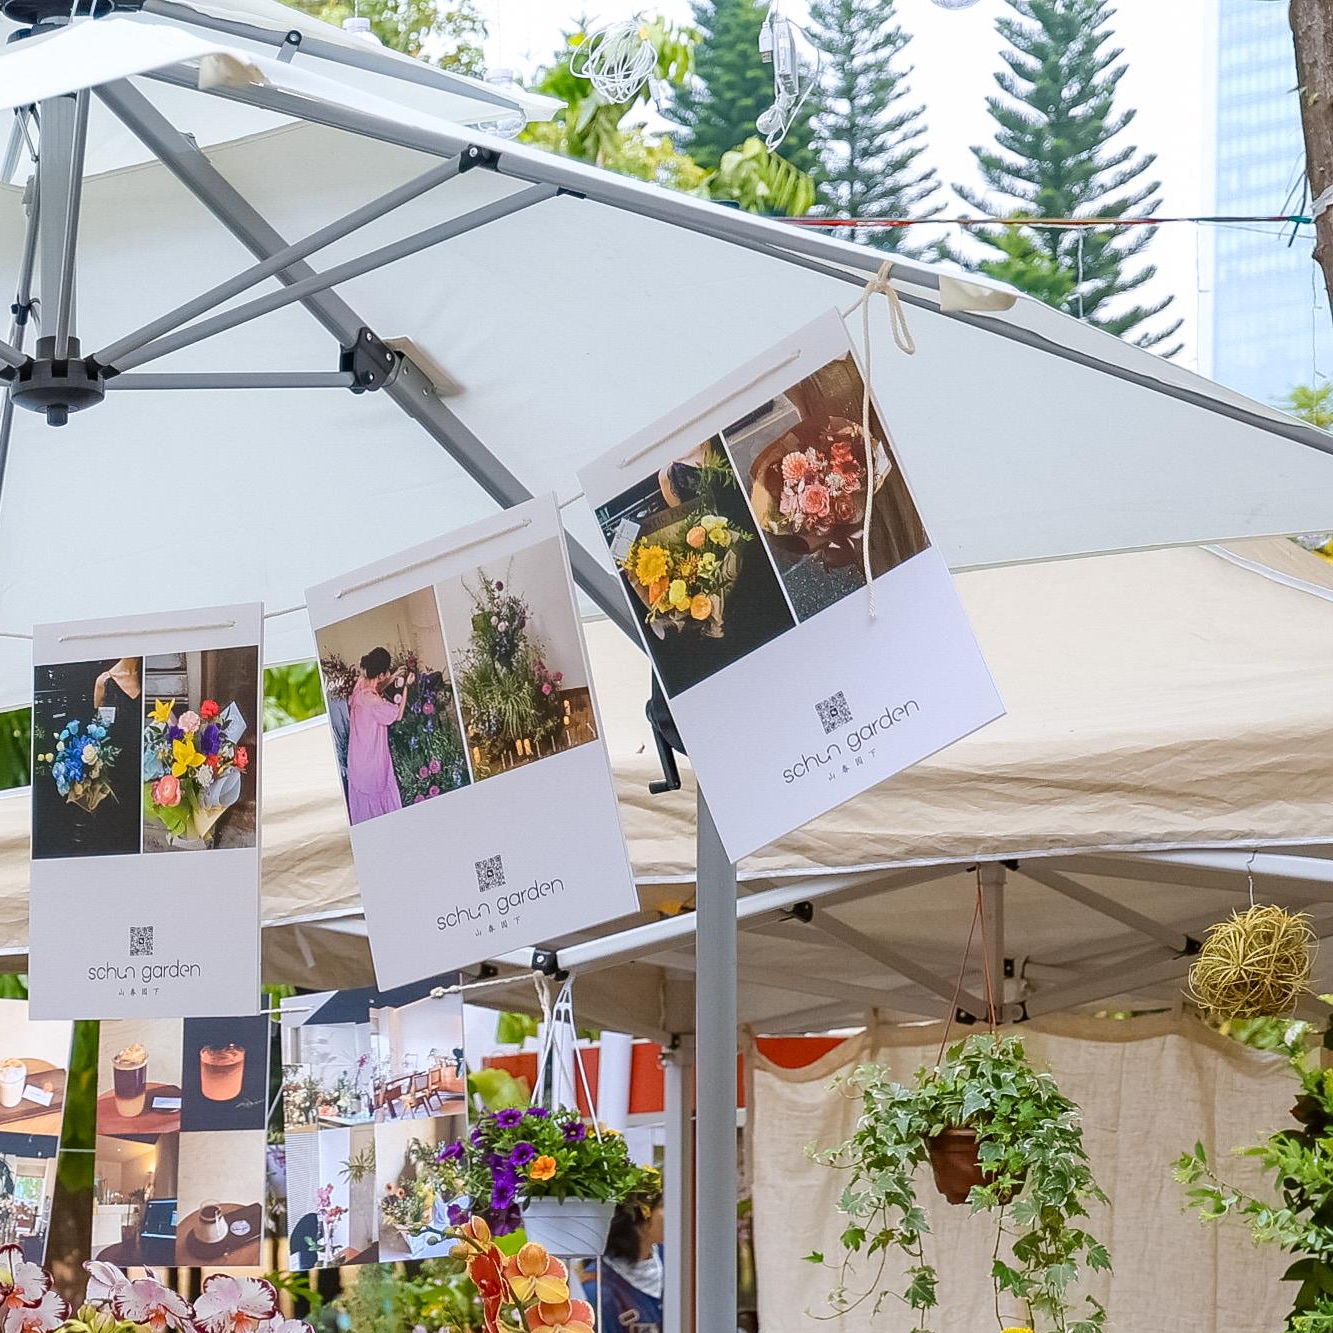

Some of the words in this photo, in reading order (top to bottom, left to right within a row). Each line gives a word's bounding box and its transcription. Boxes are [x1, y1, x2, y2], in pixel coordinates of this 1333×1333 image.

[783, 744, 841, 783] schun
[846, 700, 920, 752] garden
[437, 903, 490, 930] schun
[497, 879, 564, 915] garden
[88, 961, 136, 980] schun
[141, 959, 201, 983] garden
